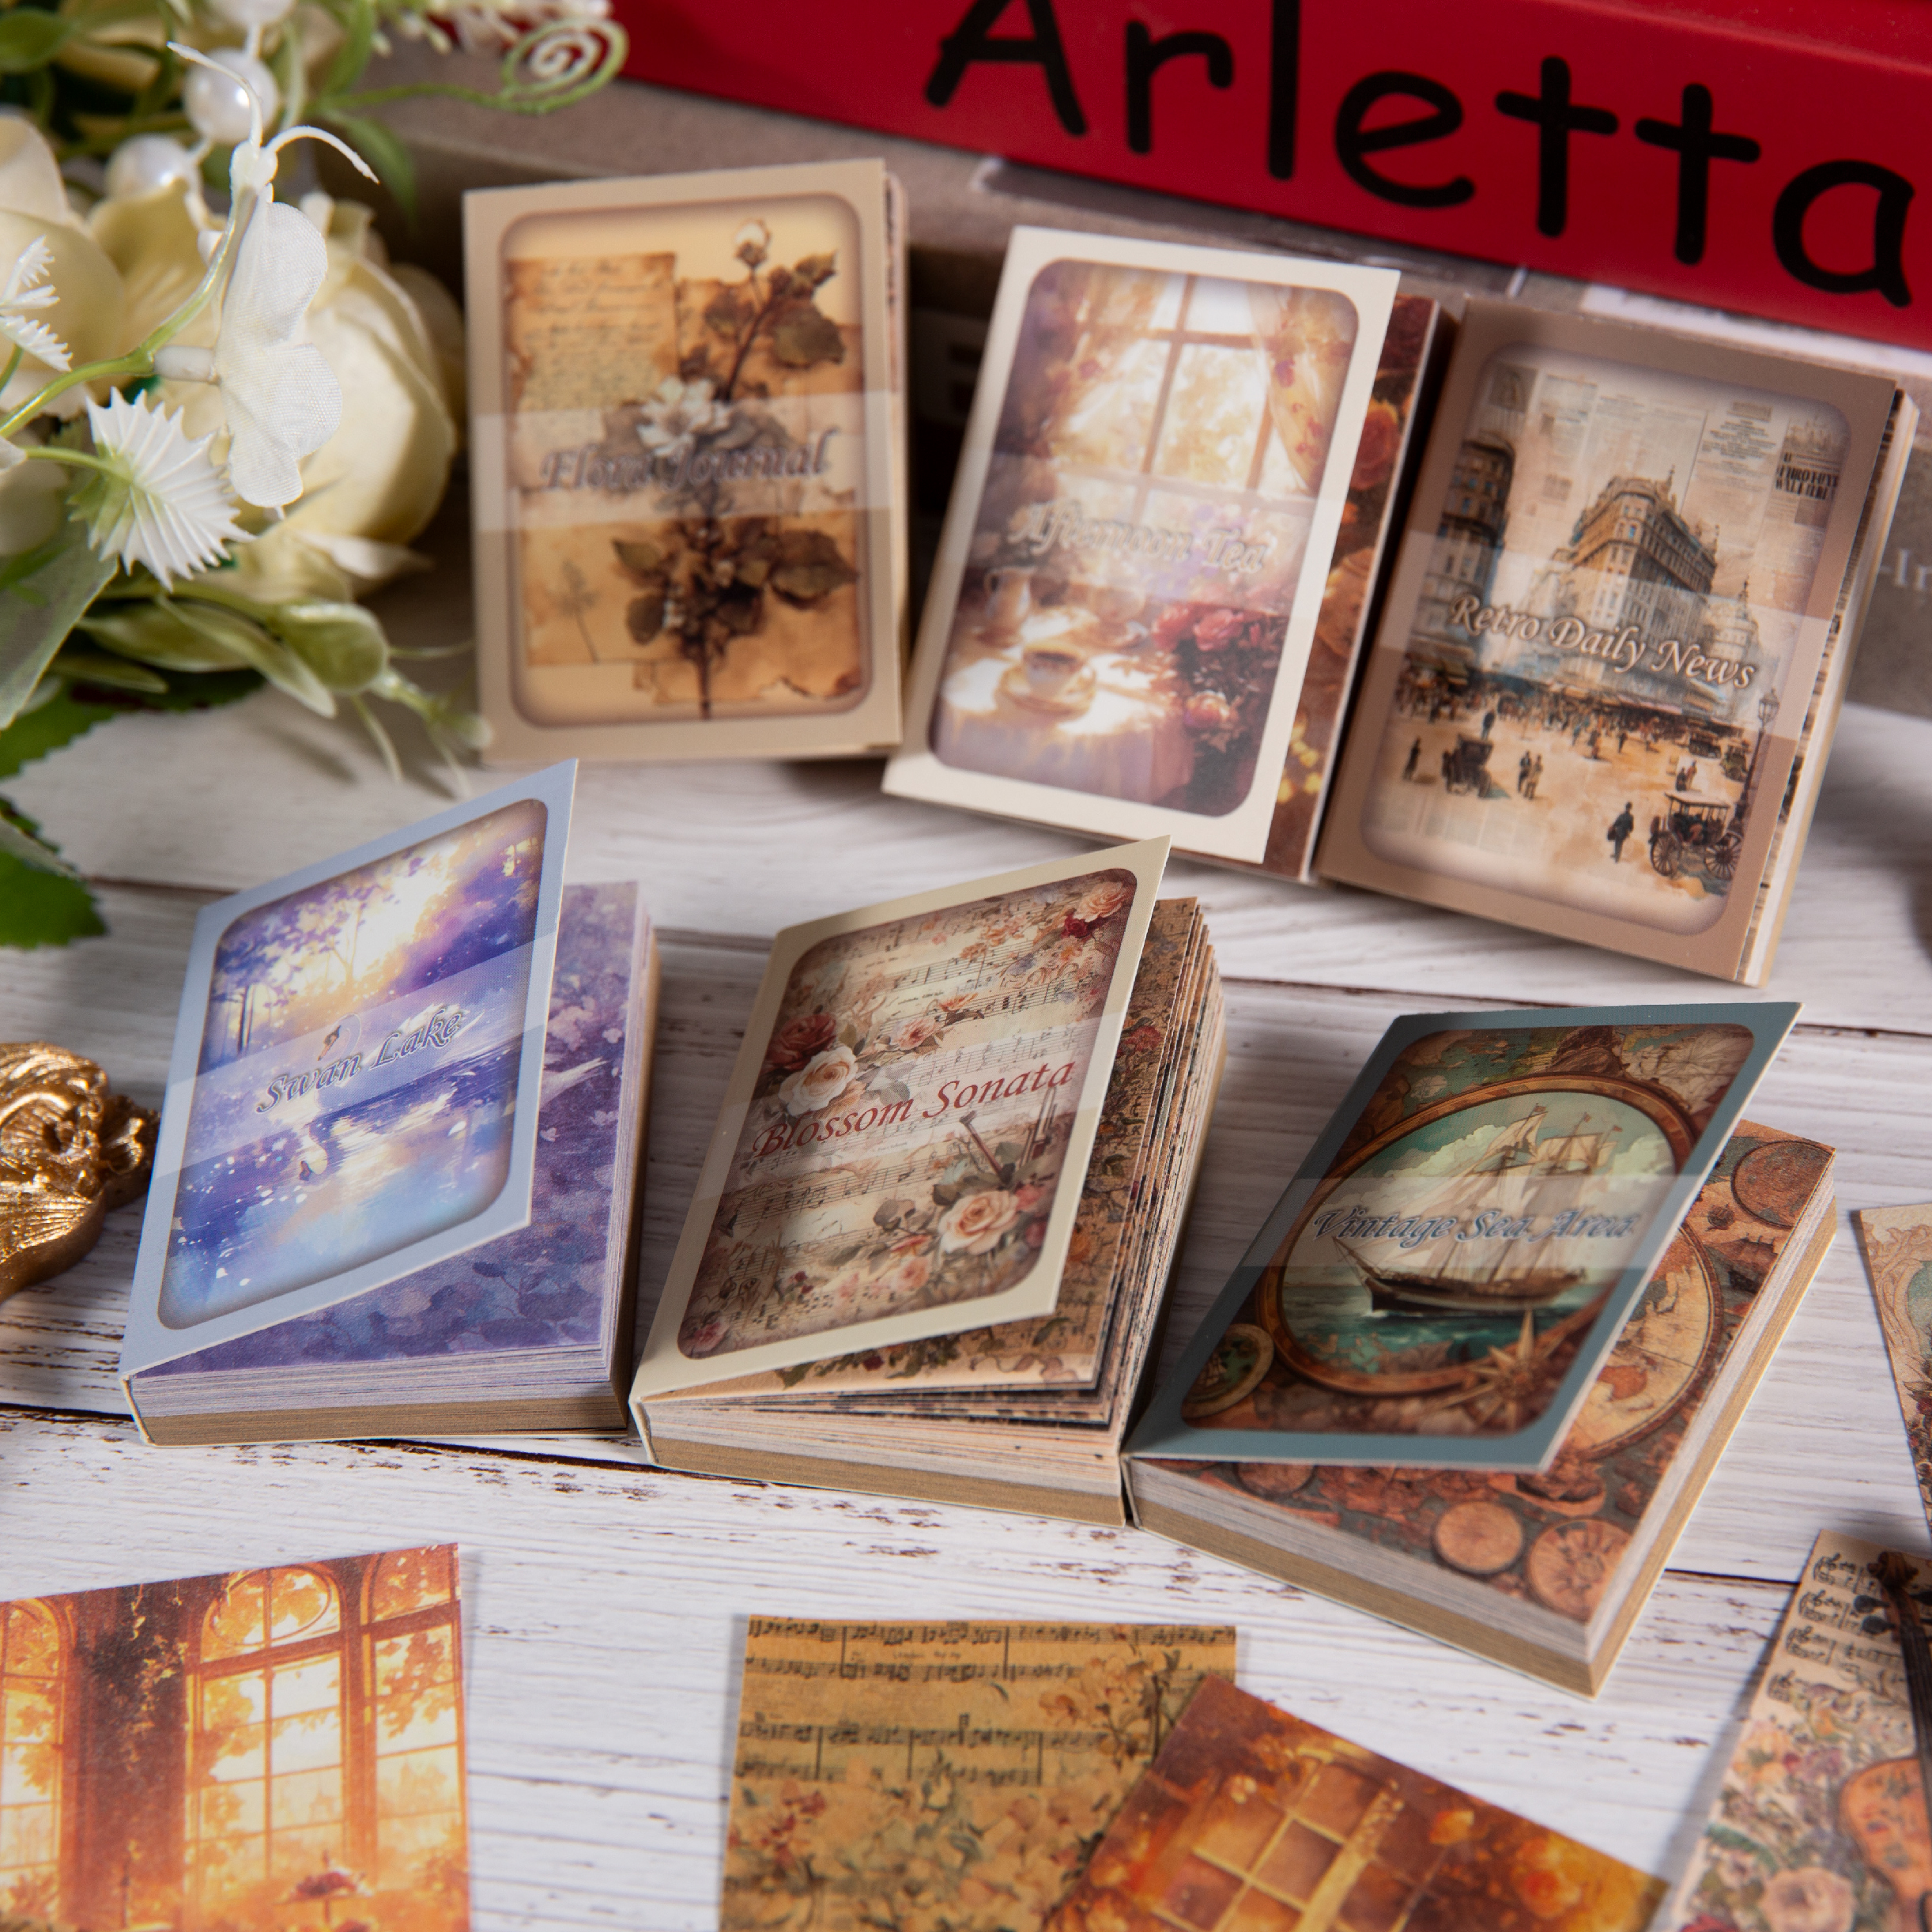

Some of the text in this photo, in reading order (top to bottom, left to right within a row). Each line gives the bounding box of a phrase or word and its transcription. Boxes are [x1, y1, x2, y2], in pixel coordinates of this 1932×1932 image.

[924, 0, 1915, 308] Arletta
[659, 428, 839, 492] Journal
[1007, 500, 1268, 572] Afternoon Tea
[1451, 594, 1755, 689] Retro Daily News
[255, 1008, 462, 1114] Swan Lake
[753, 1061, 1075, 1157] Blossom Sonata
[1313, 1206, 1636, 1249] Vintage Sea Area
